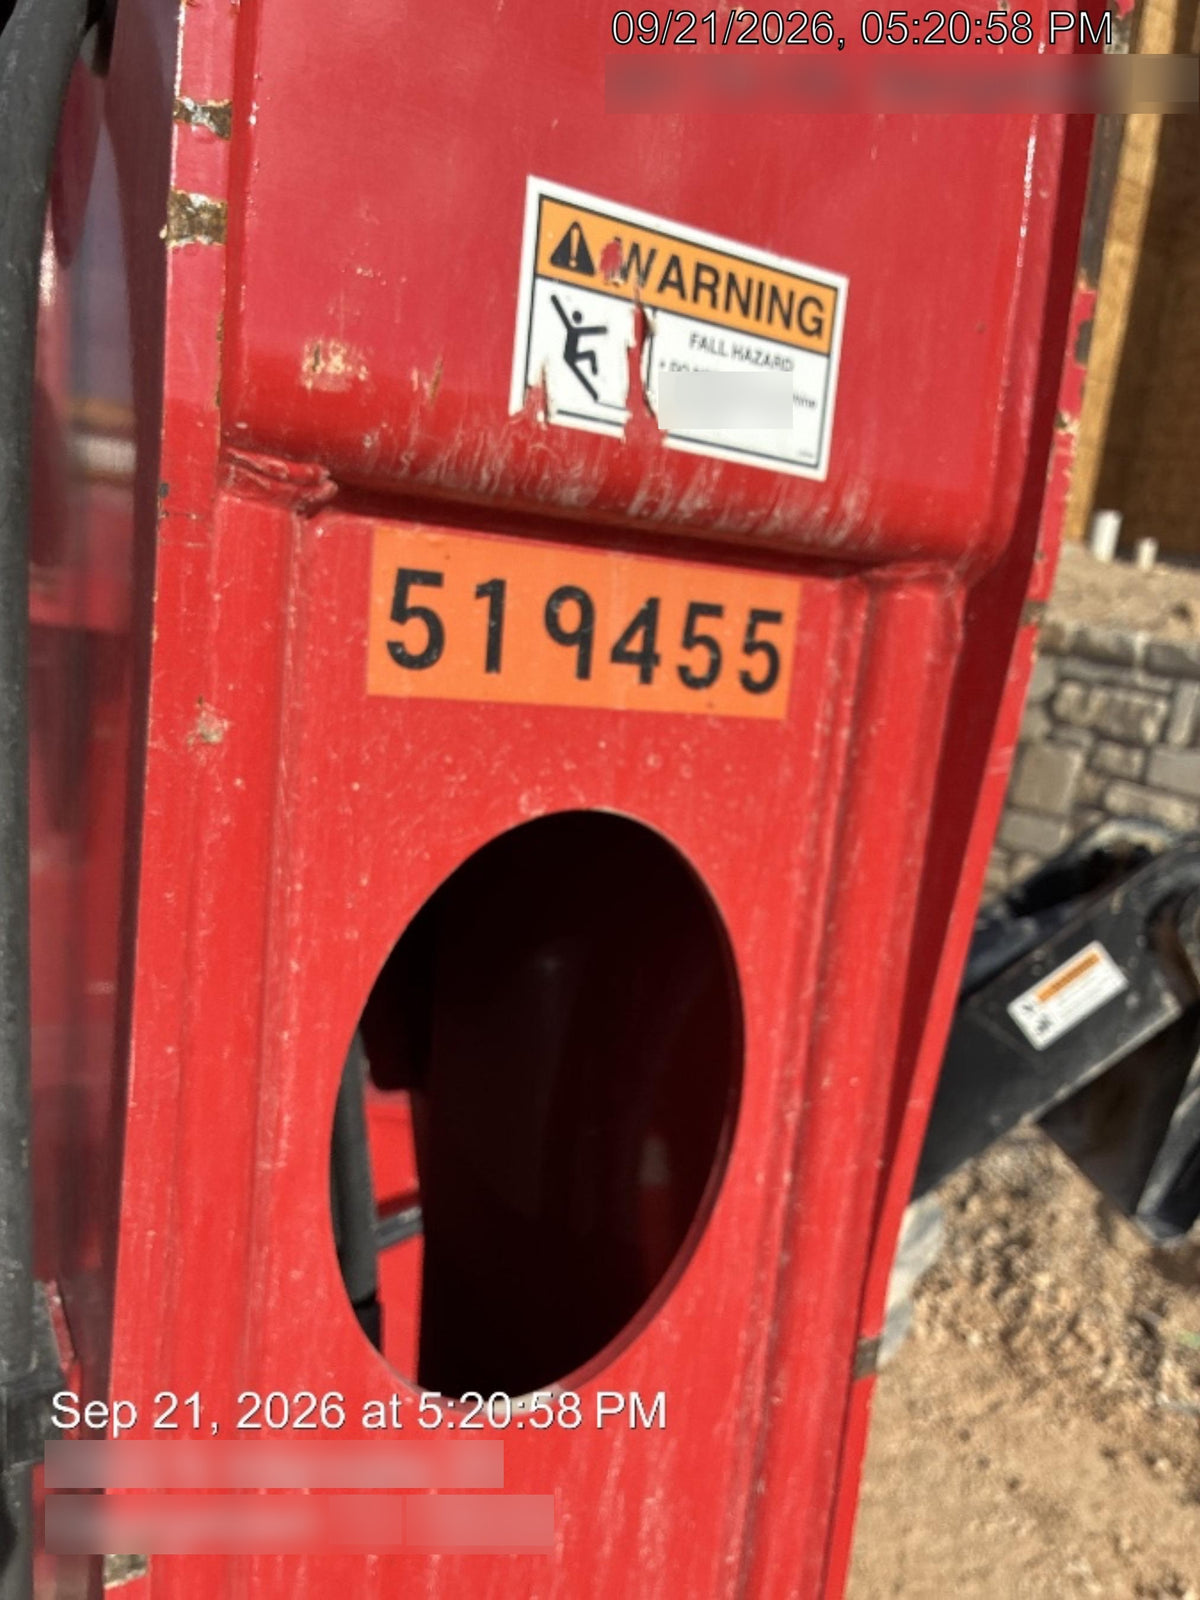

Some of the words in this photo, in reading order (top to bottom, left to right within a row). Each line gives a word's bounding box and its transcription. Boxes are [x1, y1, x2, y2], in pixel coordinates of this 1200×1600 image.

[613, 237, 824, 338] WARNING
[689, 332, 728, 358] FALL
[731, 344, 794, 372] HAZARD
[386, 567, 785, 695] 519455
